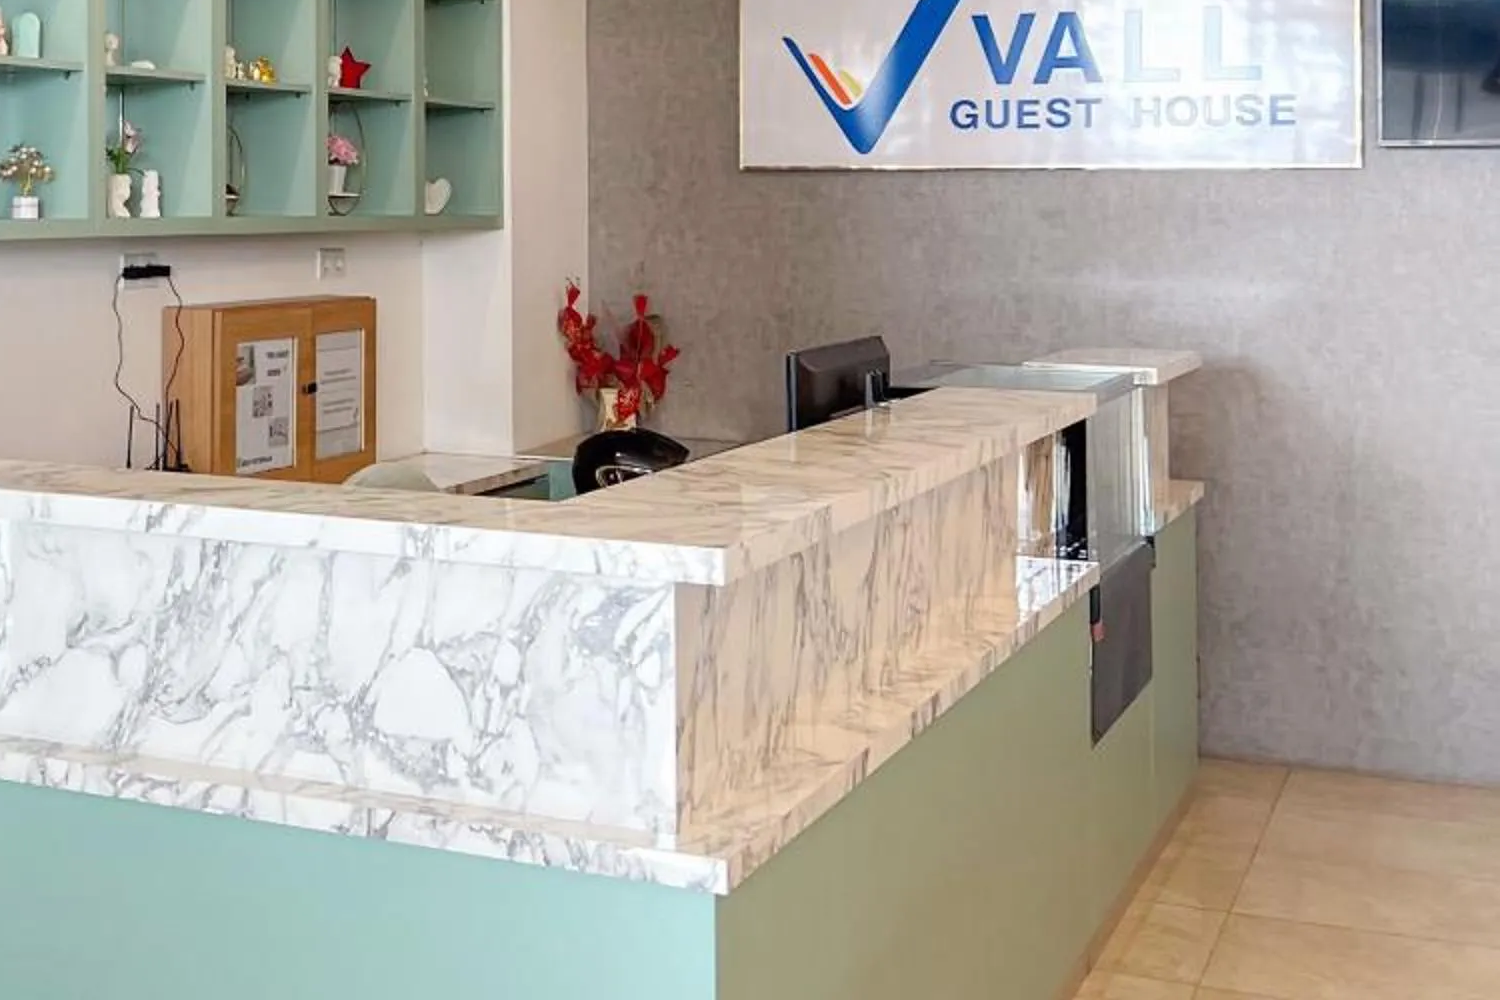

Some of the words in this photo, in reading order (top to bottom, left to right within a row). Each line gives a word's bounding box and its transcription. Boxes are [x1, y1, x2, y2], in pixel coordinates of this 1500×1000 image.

[971, 5, 1262, 85] VALL
[950, 98, 1103, 129] GUEST
[1131, 93, 1297, 128] HOUSE
